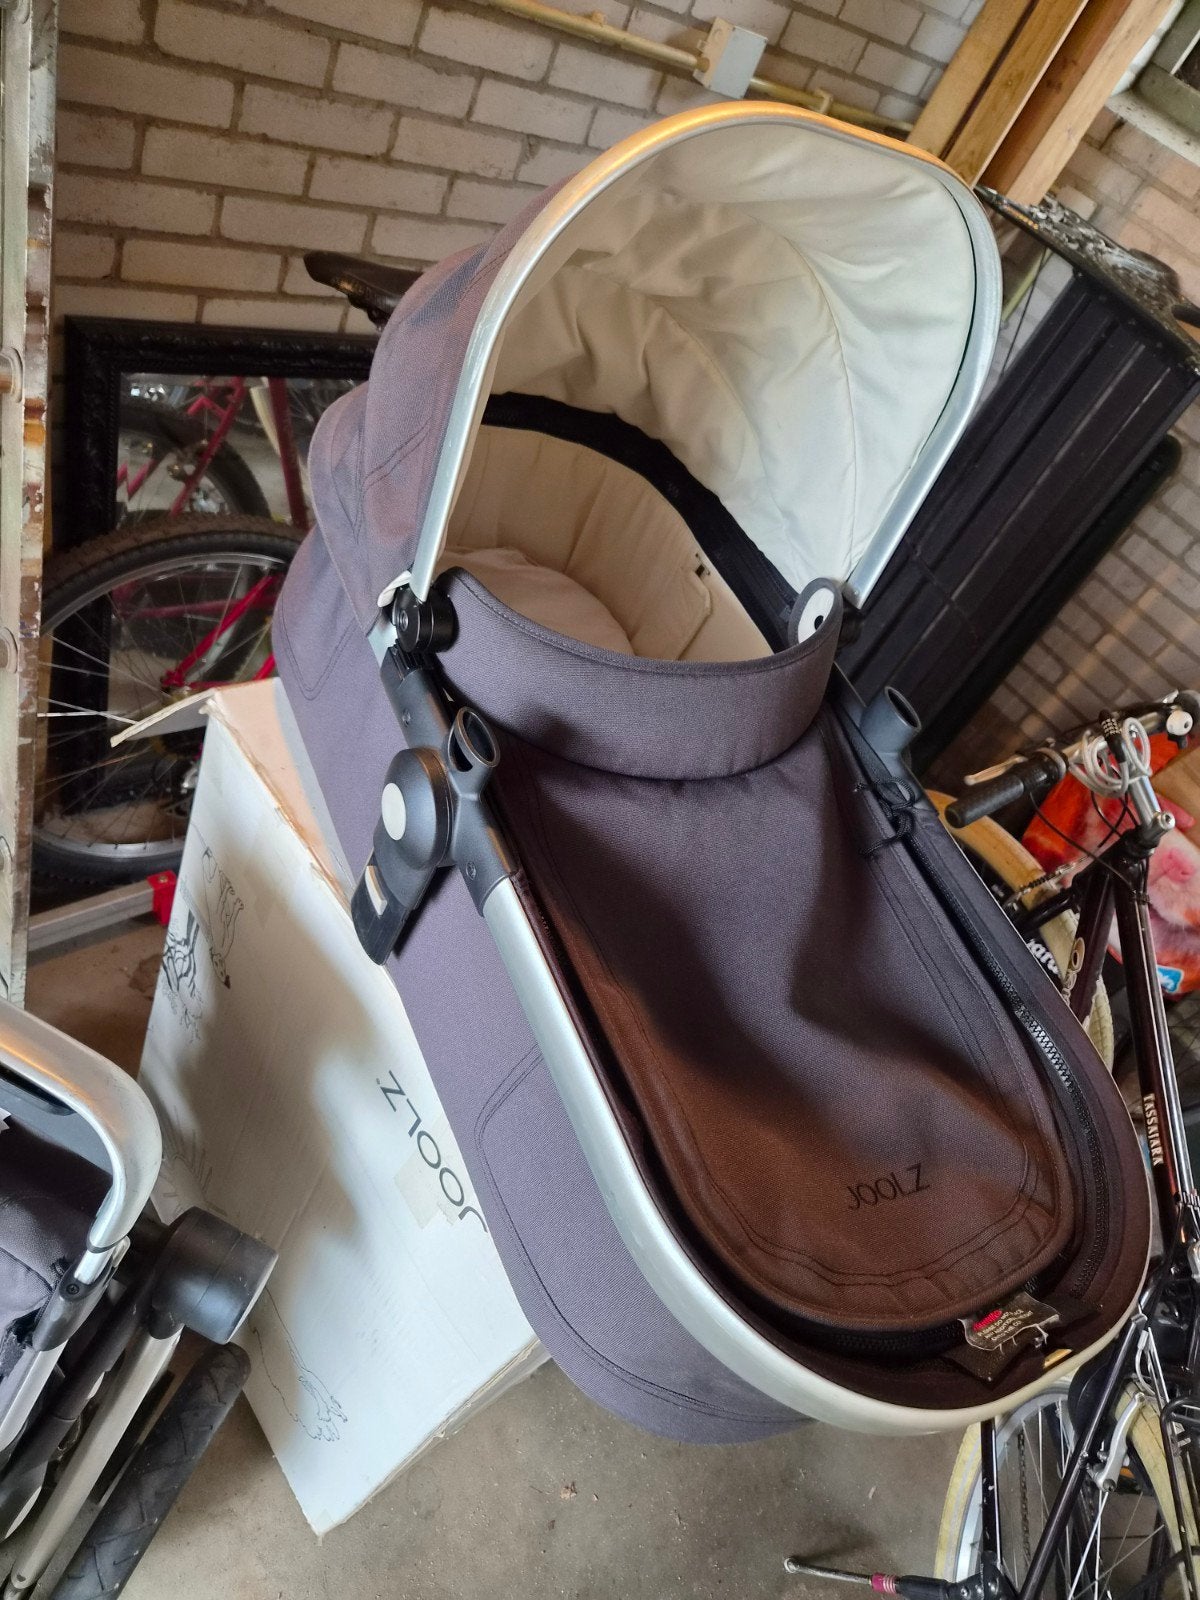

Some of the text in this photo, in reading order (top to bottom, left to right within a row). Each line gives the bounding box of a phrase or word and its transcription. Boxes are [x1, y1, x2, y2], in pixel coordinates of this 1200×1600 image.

[379, 1070, 488, 1233] JOOLZ
[1143, 1092, 1164, 1167] TASSAJARA
[847, 1162, 931, 1211] JOOLZ
